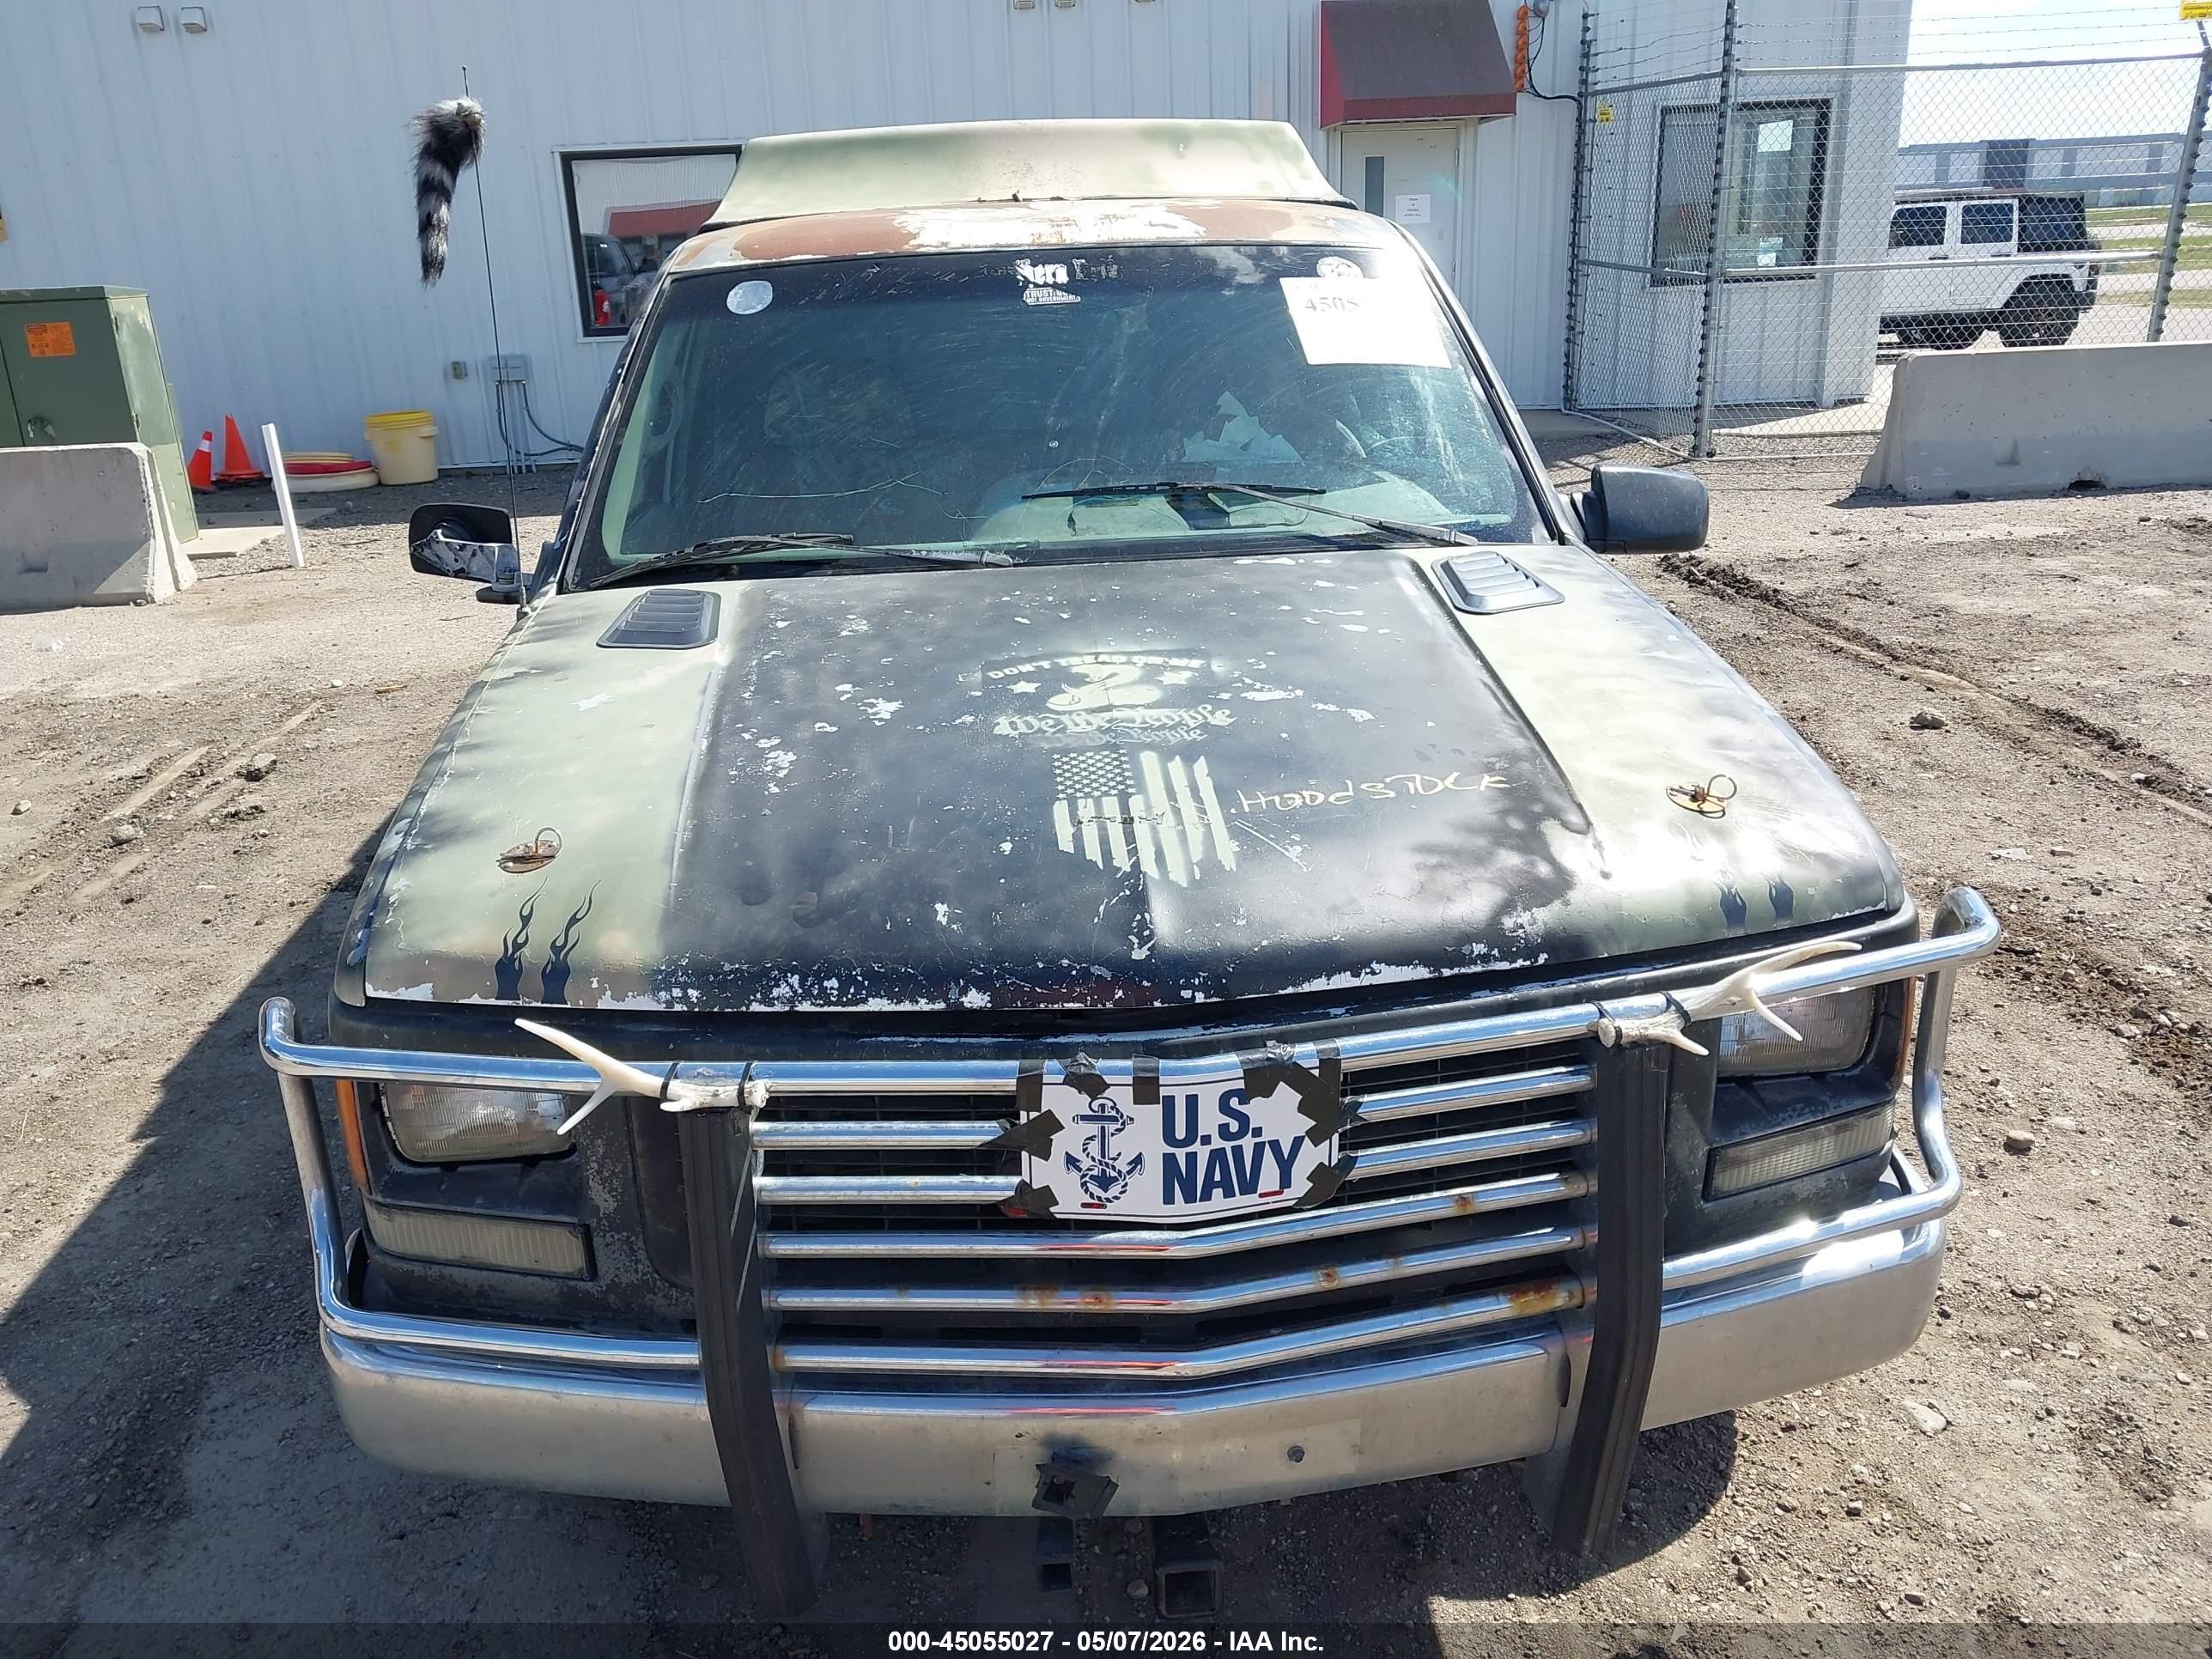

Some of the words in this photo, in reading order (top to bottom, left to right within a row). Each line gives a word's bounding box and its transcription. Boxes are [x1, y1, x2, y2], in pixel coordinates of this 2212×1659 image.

[1025, 289, 1054, 297] TRUST
[987, 659, 1052, 679] DON'T
[1054, 653, 1127, 667] TREAD
[1131, 654, 1164, 666] ON
[1166, 657, 1206, 669] ME
[1161, 1088, 1263, 1149] U.S.
[1162, 1135, 1306, 1206] NAVY
